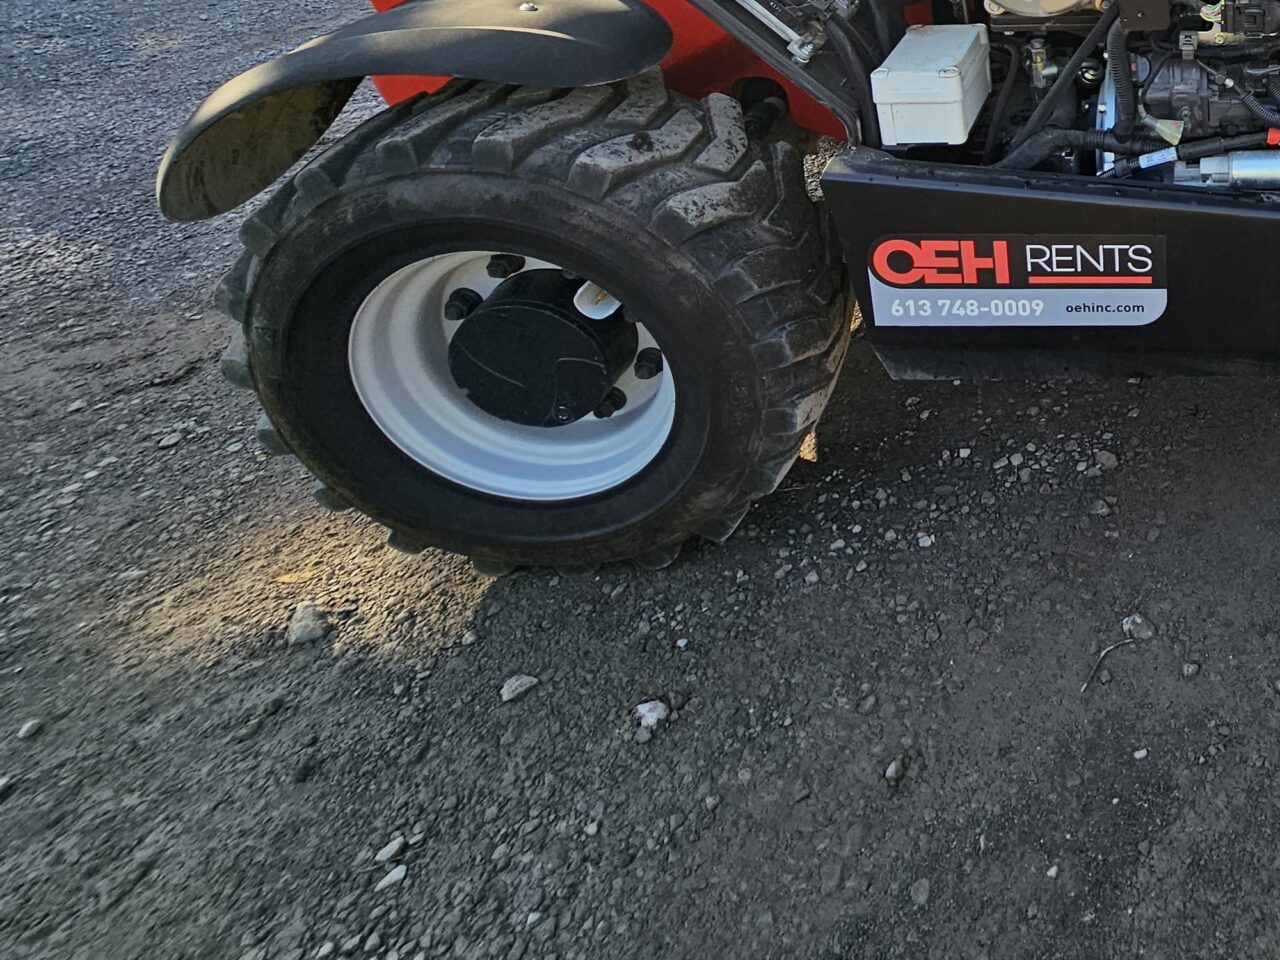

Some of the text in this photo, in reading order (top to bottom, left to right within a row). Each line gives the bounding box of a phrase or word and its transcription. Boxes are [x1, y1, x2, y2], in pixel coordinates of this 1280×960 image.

[873, 239, 1153, 284] OEH RENTS
[891, 299, 1145, 317] 613 748-0009 oehinc.com
